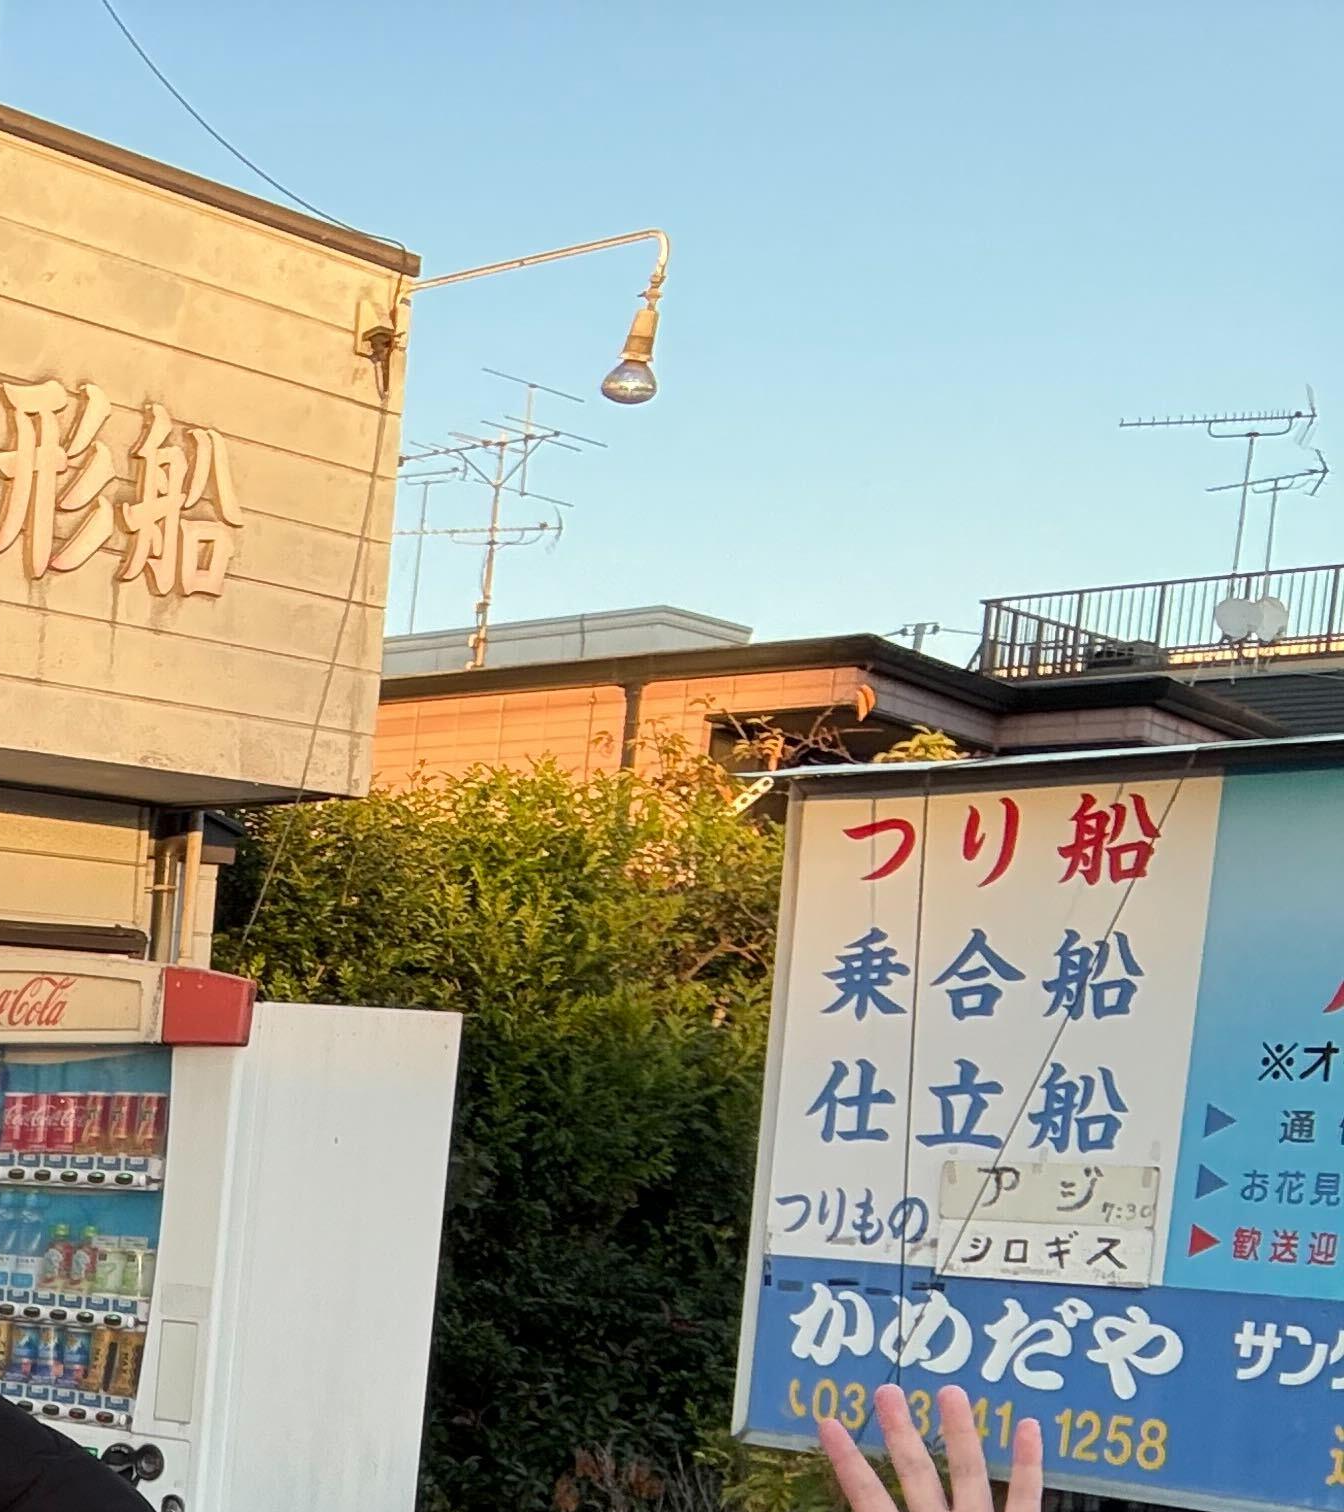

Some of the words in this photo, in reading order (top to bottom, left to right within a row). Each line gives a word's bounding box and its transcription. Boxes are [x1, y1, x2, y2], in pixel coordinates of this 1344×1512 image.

[842, 792, 1161, 889] つり船
[820, 927, 1145, 1021] 乗合船
[806, 1058, 1129, 1155] 仕立船
[1279, 1109, 1344, 1145] 通
[775, 1188, 930, 1246] つりもの
[977, 1165, 1105, 1212] アジ
[961, 1230, 1128, 1270] シロギス
[789, 1281, 1185, 1402] かめだや
